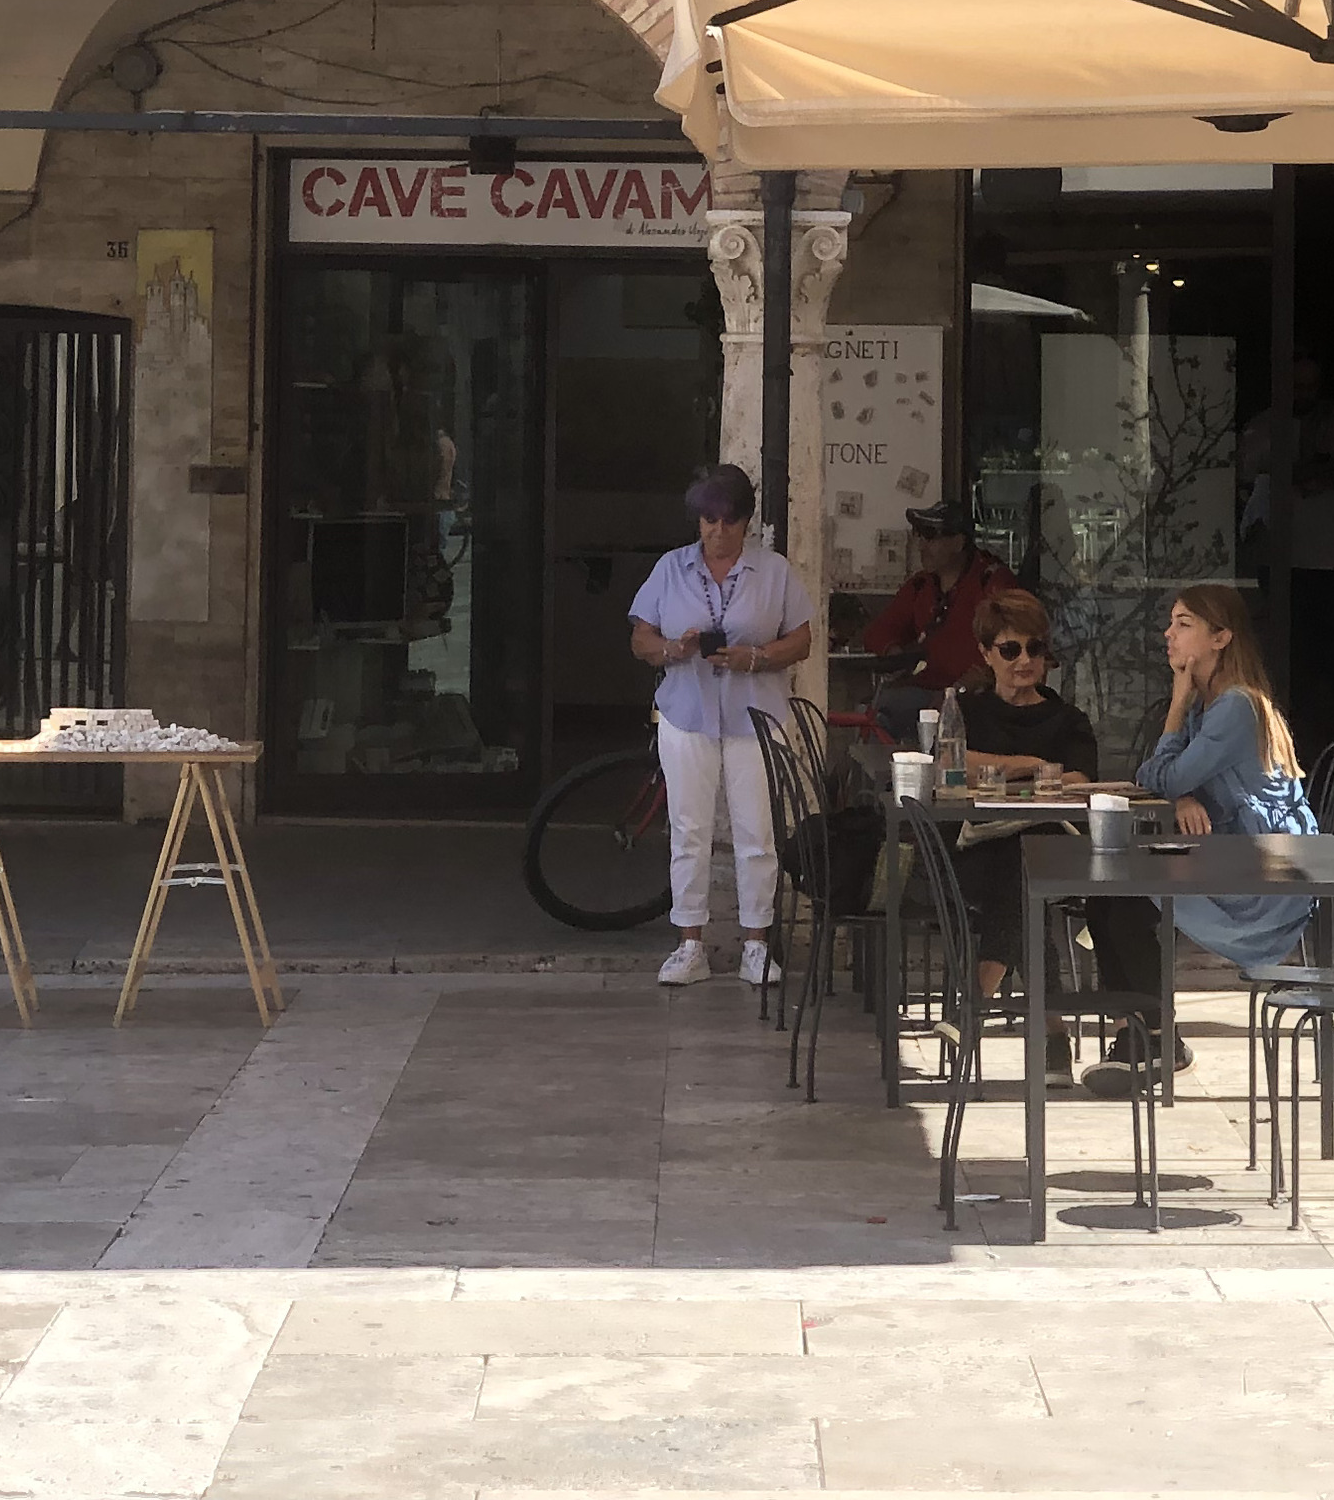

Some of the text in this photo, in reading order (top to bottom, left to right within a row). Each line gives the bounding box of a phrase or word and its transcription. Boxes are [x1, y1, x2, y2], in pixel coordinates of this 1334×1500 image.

[302, 167, 713, 220] CAVE CAVAM
[824, 341, 898, 359] GNETI
[825, 443, 888, 464] TONE
